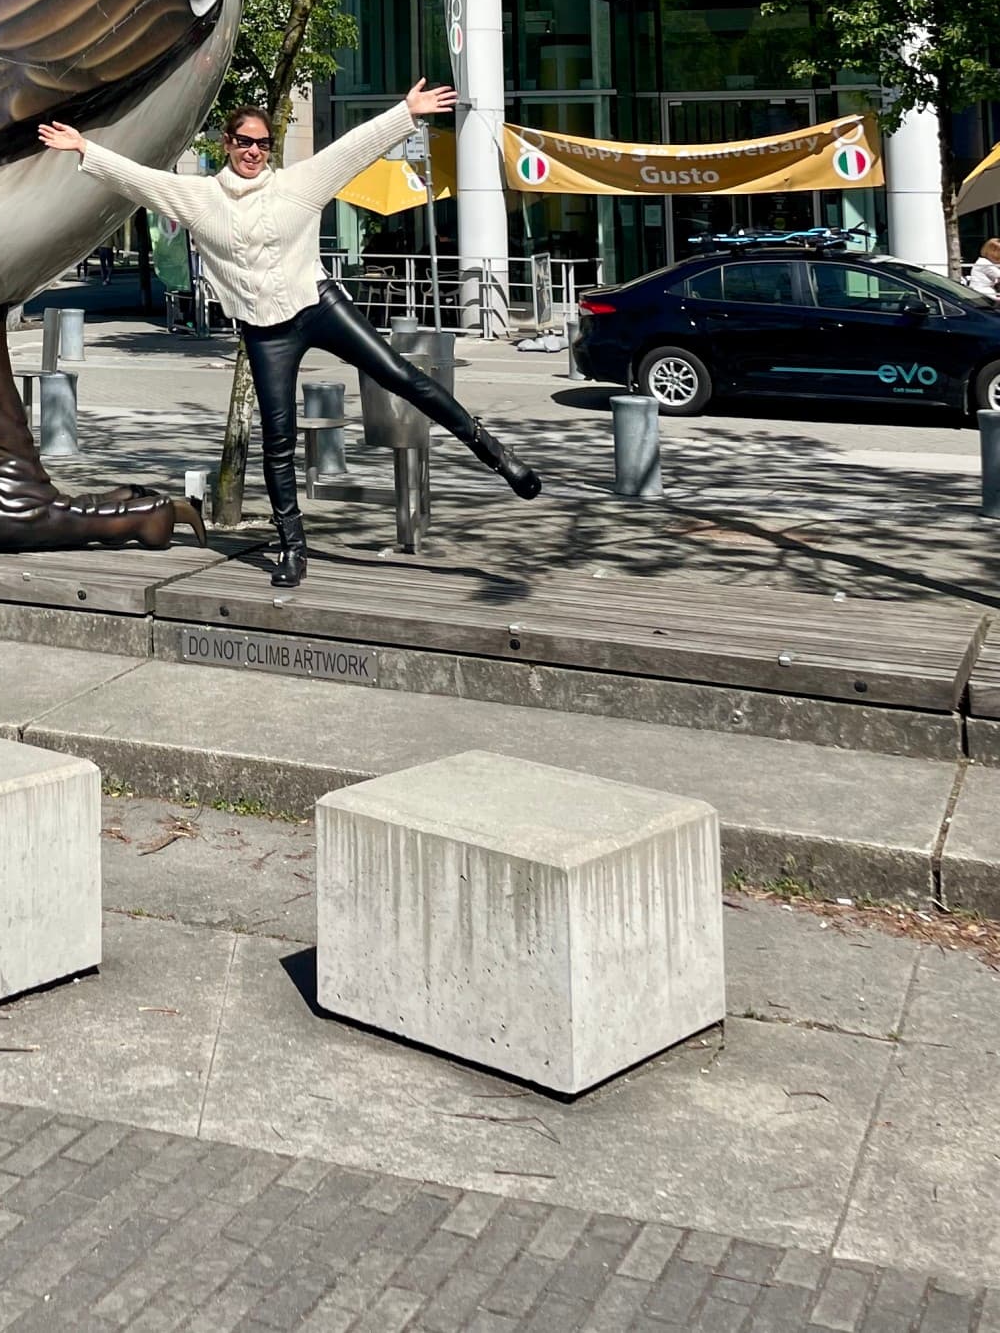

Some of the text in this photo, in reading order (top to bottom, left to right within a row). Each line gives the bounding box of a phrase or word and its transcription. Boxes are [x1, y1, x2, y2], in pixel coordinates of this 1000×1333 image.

[554, 138, 622, 163] Happy
[675, 135, 820, 161] Anniversary
[640, 165, 720, 185] Gusto
[878, 362, 938, 385] evo
[188, 636, 370, 677] DO NOT CLIMB ARTWORK
